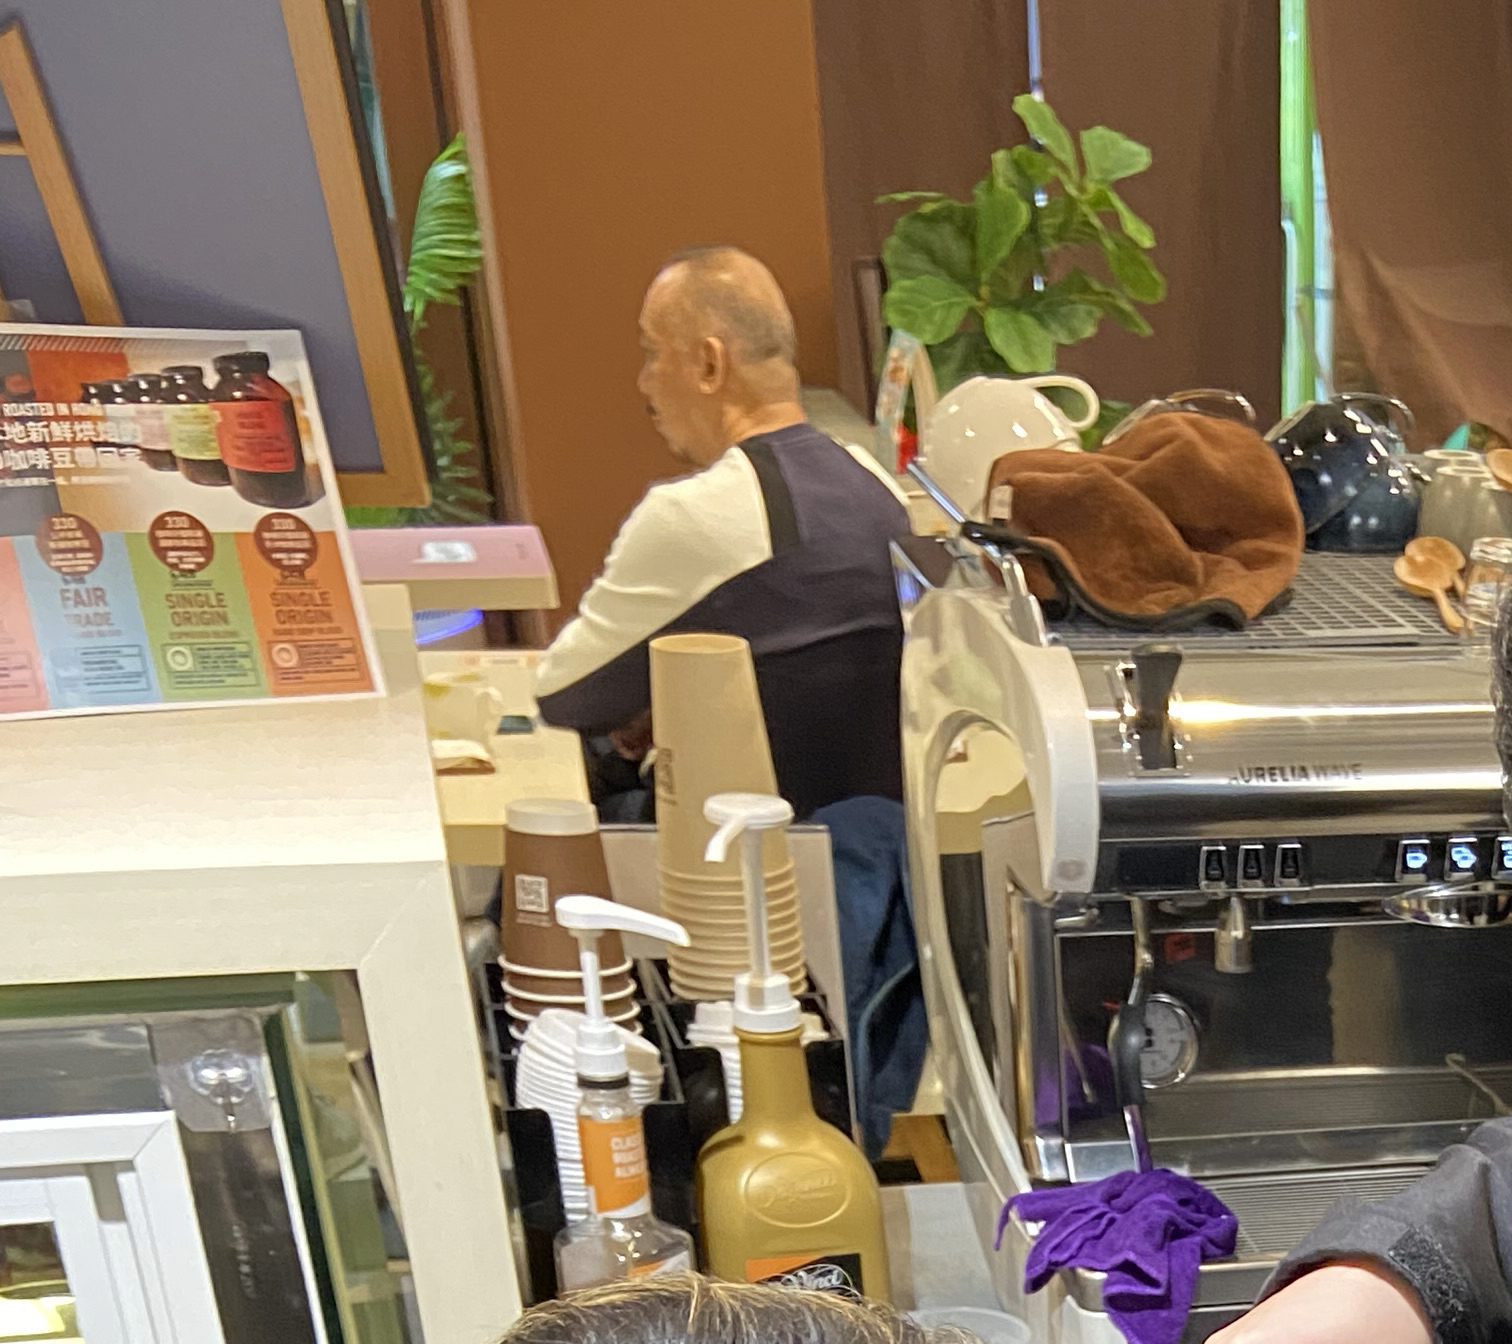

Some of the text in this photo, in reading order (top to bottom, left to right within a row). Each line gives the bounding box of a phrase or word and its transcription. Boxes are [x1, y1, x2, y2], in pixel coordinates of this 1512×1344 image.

[59, 587, 109, 609] FAIR
[165, 592, 228, 608] SINGLE
[269, 591, 334, 607] SINGLE
[64, 612, 115, 627] TRADE
[170, 610, 230, 627] ORIGIN
[275, 609, 335, 625] ORIGIN
